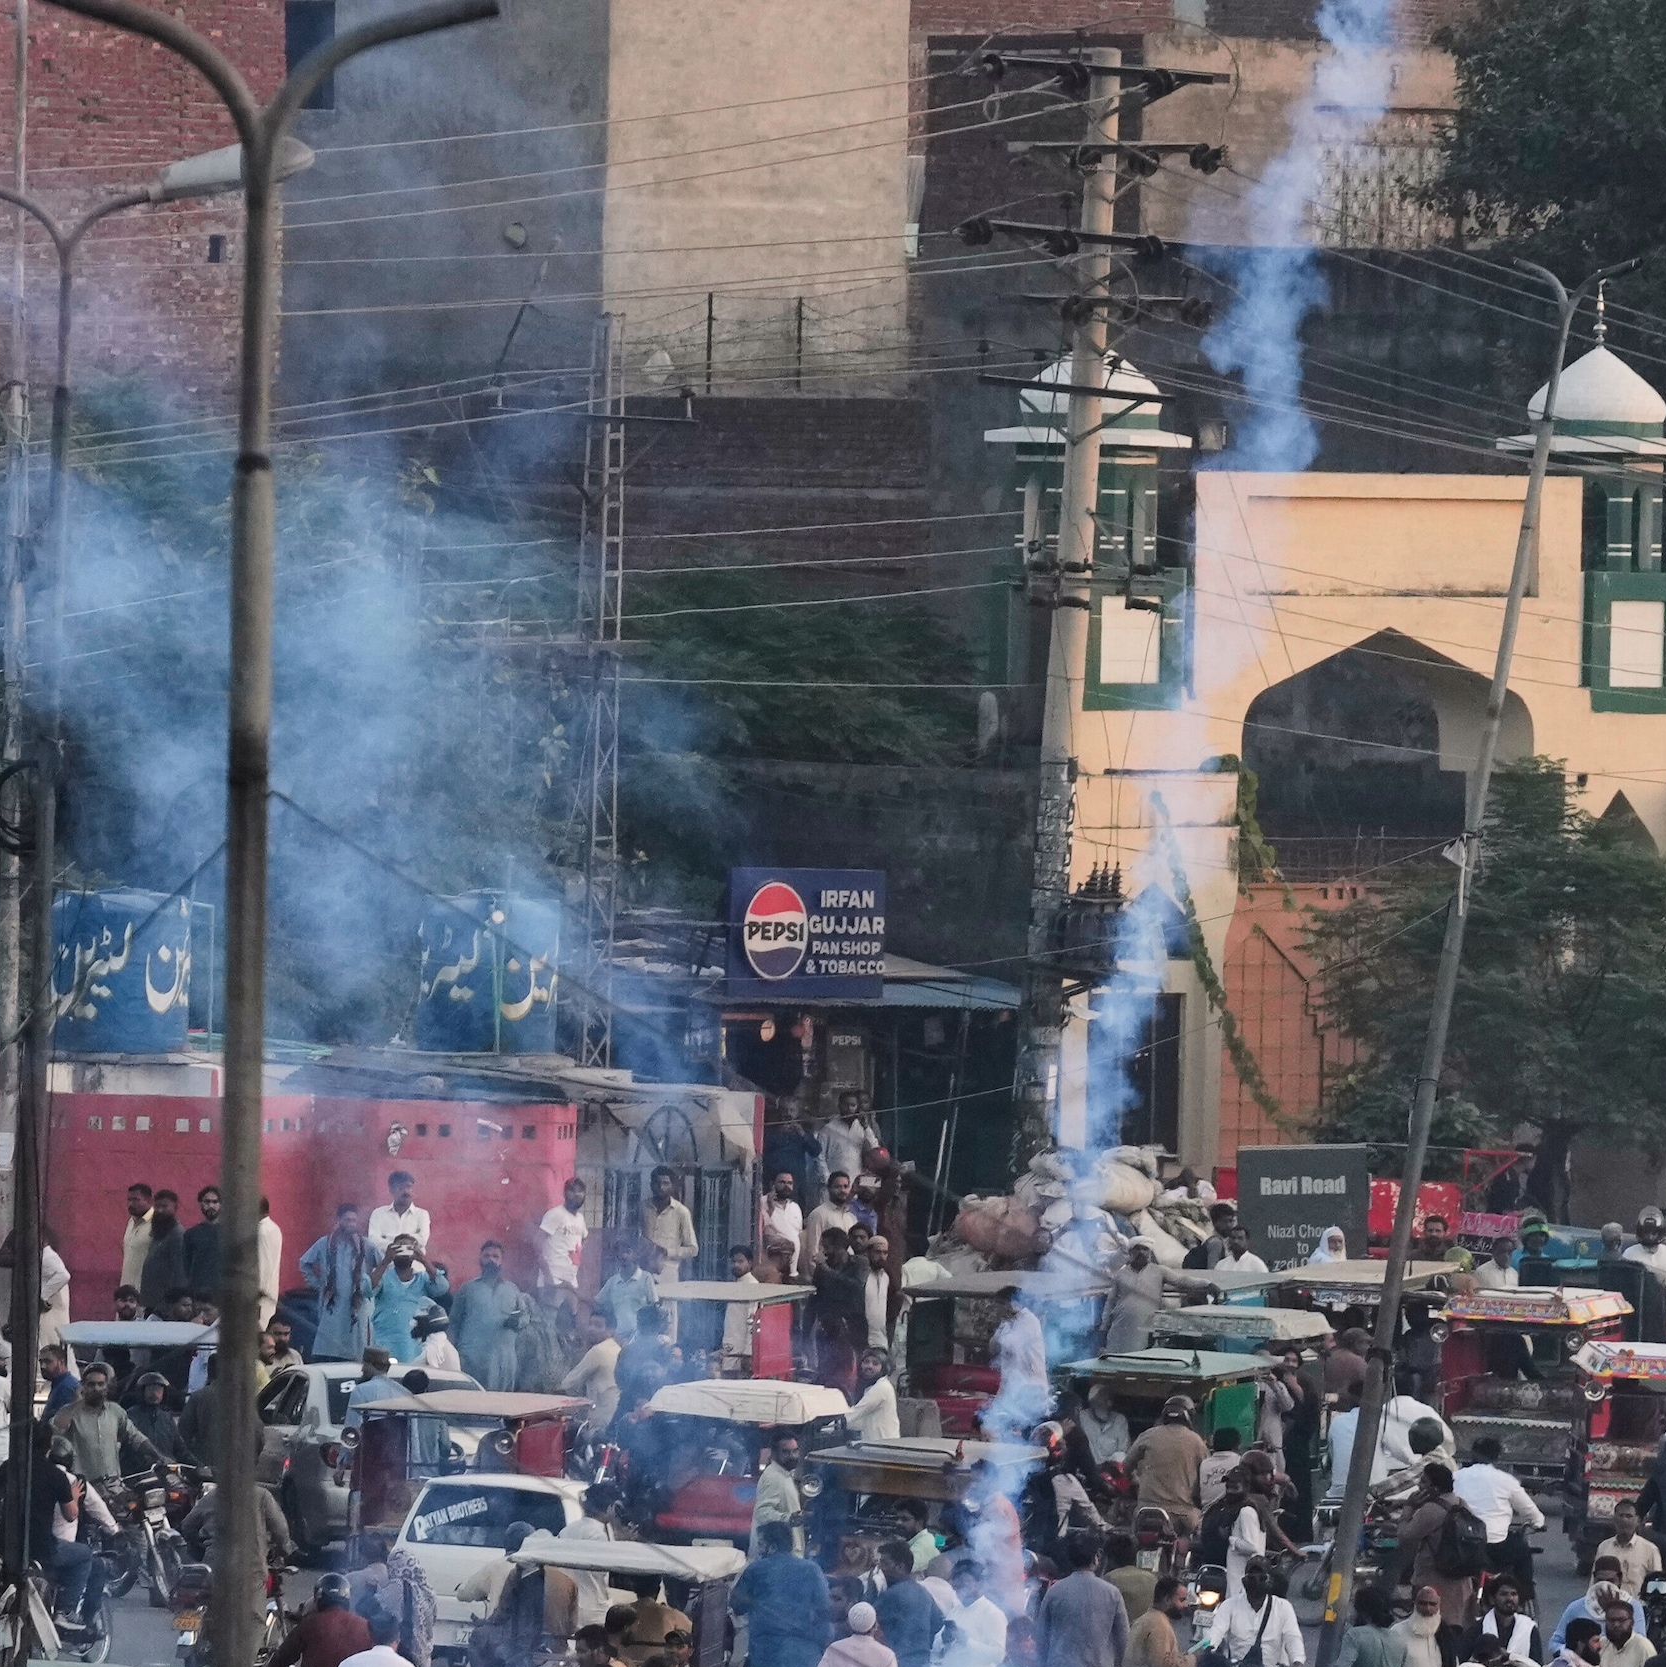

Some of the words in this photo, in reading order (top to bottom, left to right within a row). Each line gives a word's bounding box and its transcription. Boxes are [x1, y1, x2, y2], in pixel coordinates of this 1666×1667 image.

[820, 889, 875, 909] IRFAN
[747, 920, 805, 942] PEPSI
[808, 914, 885, 935] GUJJAR
[812, 941, 840, 955] PAN
[841, 941, 882, 956] SHOP
[805, 959, 816, 974] &
[818, 959, 886, 974] TOBACCO
[831, 1035, 862, 1046] PEPSI
[1260, 1175, 1298, 1196] Ravi
[1301, 1174, 1346, 1196] Road
[1267, 1224, 1295, 1239] Niazi
[1298, 1223, 1338, 1239] Cho
[1296, 1241, 1309, 1254] to
[447, 1496, 489, 1523] BROTHERS
